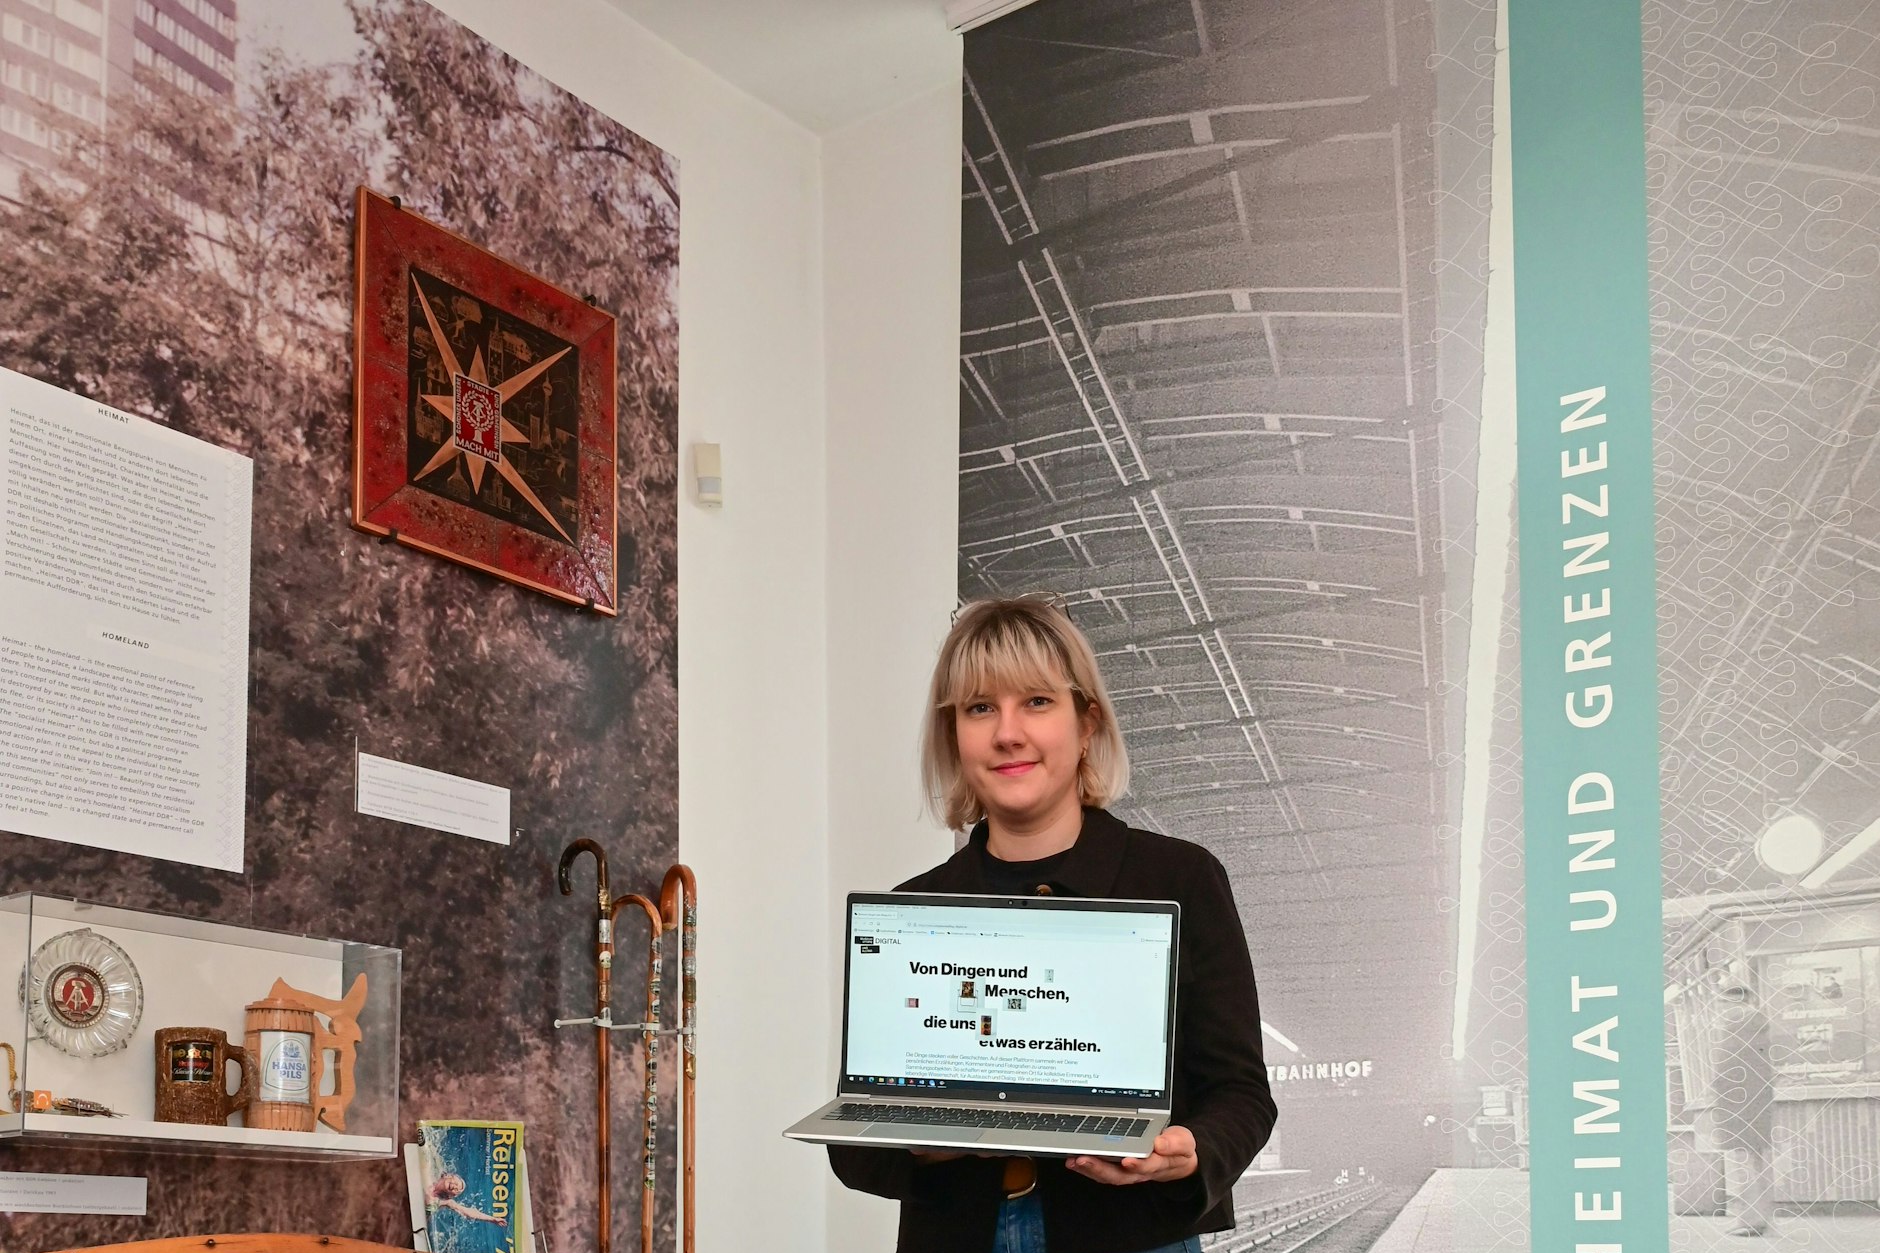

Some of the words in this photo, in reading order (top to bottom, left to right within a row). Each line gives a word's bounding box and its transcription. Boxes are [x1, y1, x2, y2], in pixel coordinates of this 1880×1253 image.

[98, 408, 130, 424] HEIMAT
[9, 438, 47, 455] Auffassung
[75, 460, 90, 469] Welt
[120, 475, 133, 484] Was
[10, 418, 31, 428] einem
[48, 432, 65, 440] einer
[67, 438, 102, 454] Landschaft
[128, 460, 153, 471] anderen
[155, 469, 168, 477] dort
[170, 474, 198, 486] lebenden
[75, 432, 111, 446] emotionale
[113, 444, 153, 462] Bezugspunkt
[168, 463, 198, 477] Menschen
[456, 436, 481, 453] MACH
[484, 448, 499, 460] MIT
[8, 459, 56, 477] umgekommen
[75, 481, 109, 495] geflüchtet
[155, 507, 191, 522] Gesellschaft
[7, 488, 22, 497] DDR
[33, 497, 59, 508] deshalb
[60, 506, 76, 514] nicht
[90, 516, 128, 530] emotionaler
[171, 542, 195, 552] sondern
[5, 538, 55, 558] Verschönerung
[69, 558, 112, 574] Wohnumfelds
[138, 580, 163, 589] sondern
[1560, 384, 1612, 728] GRENZEN
[102, 631, 150, 649] HOMELAND
[7, 679, 42, 691] destroyed
[82, 698, 105, 706] people
[122, 706, 139, 714] lived
[37, 665, 70, 678] homeland
[151, 695, 179, 706] mentality
[34, 728, 66, 737] reference
[120, 747, 146, 755] political
[147, 753, 182, 763] programme
[0, 772, 42, 785] urroundings,
[73, 786, 94, 794] allows
[128, 798, 162, 808] experience
[1567, 772, 1617, 932] UND
[910, 962, 938, 975] Von
[942, 962, 996, 981] Dingen
[998, 966, 1028, 978] und
[985, 985, 1069, 1002] Menschen,
[924, 1016, 946, 1029] die
[950, 1019, 976, 1030] uns
[1028, 1038, 1101, 1052] erzählen.
[272, 1062, 306, 1072] HANSA
[280, 1070, 302, 1079] PILS
[492, 1129, 515, 1218] Reisen
